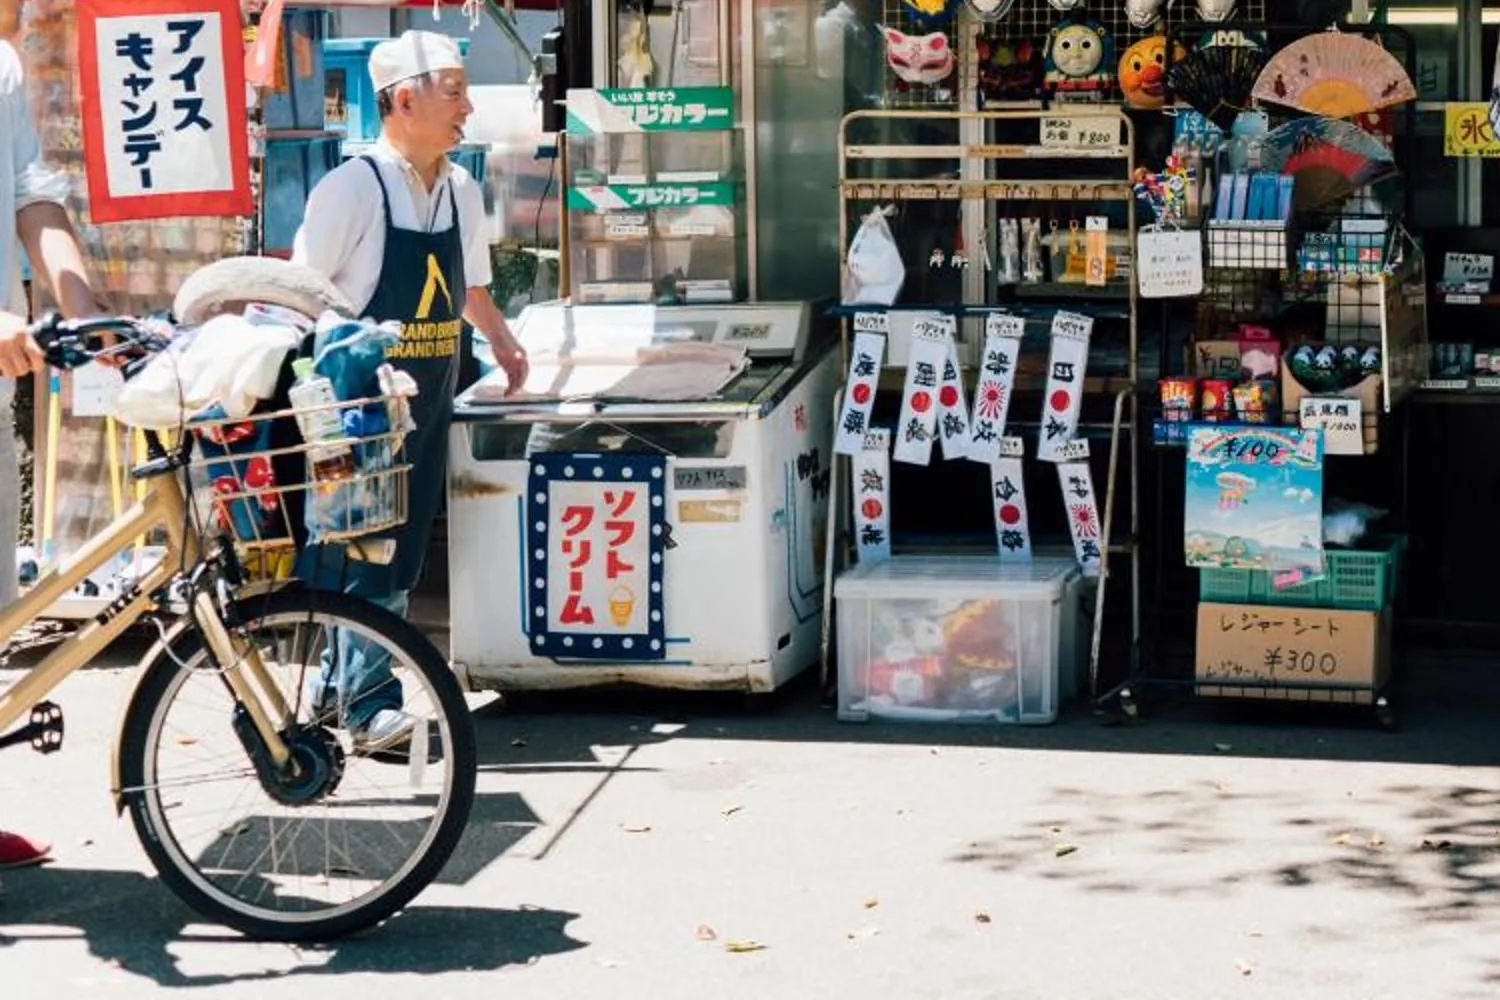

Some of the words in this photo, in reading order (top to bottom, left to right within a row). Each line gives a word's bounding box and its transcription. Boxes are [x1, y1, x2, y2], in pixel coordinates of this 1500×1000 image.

[116, 33, 161, 188] キャンデー
[166, 19, 213, 131] アイス
[1460, 115, 1490, 144] 氷
[627, 187, 716, 203] フジカラー
[973, 350, 1011, 445] 特攻
[1044, 361, 1074, 441] 日本
[602, 489, 636, 578] ソフト
[994, 476, 1025, 551] 合格
[559, 505, 595, 625] クリーム
[1220, 613, 1340, 635] レジャーシート
[1264, 646, 1336, 675] ¥300
